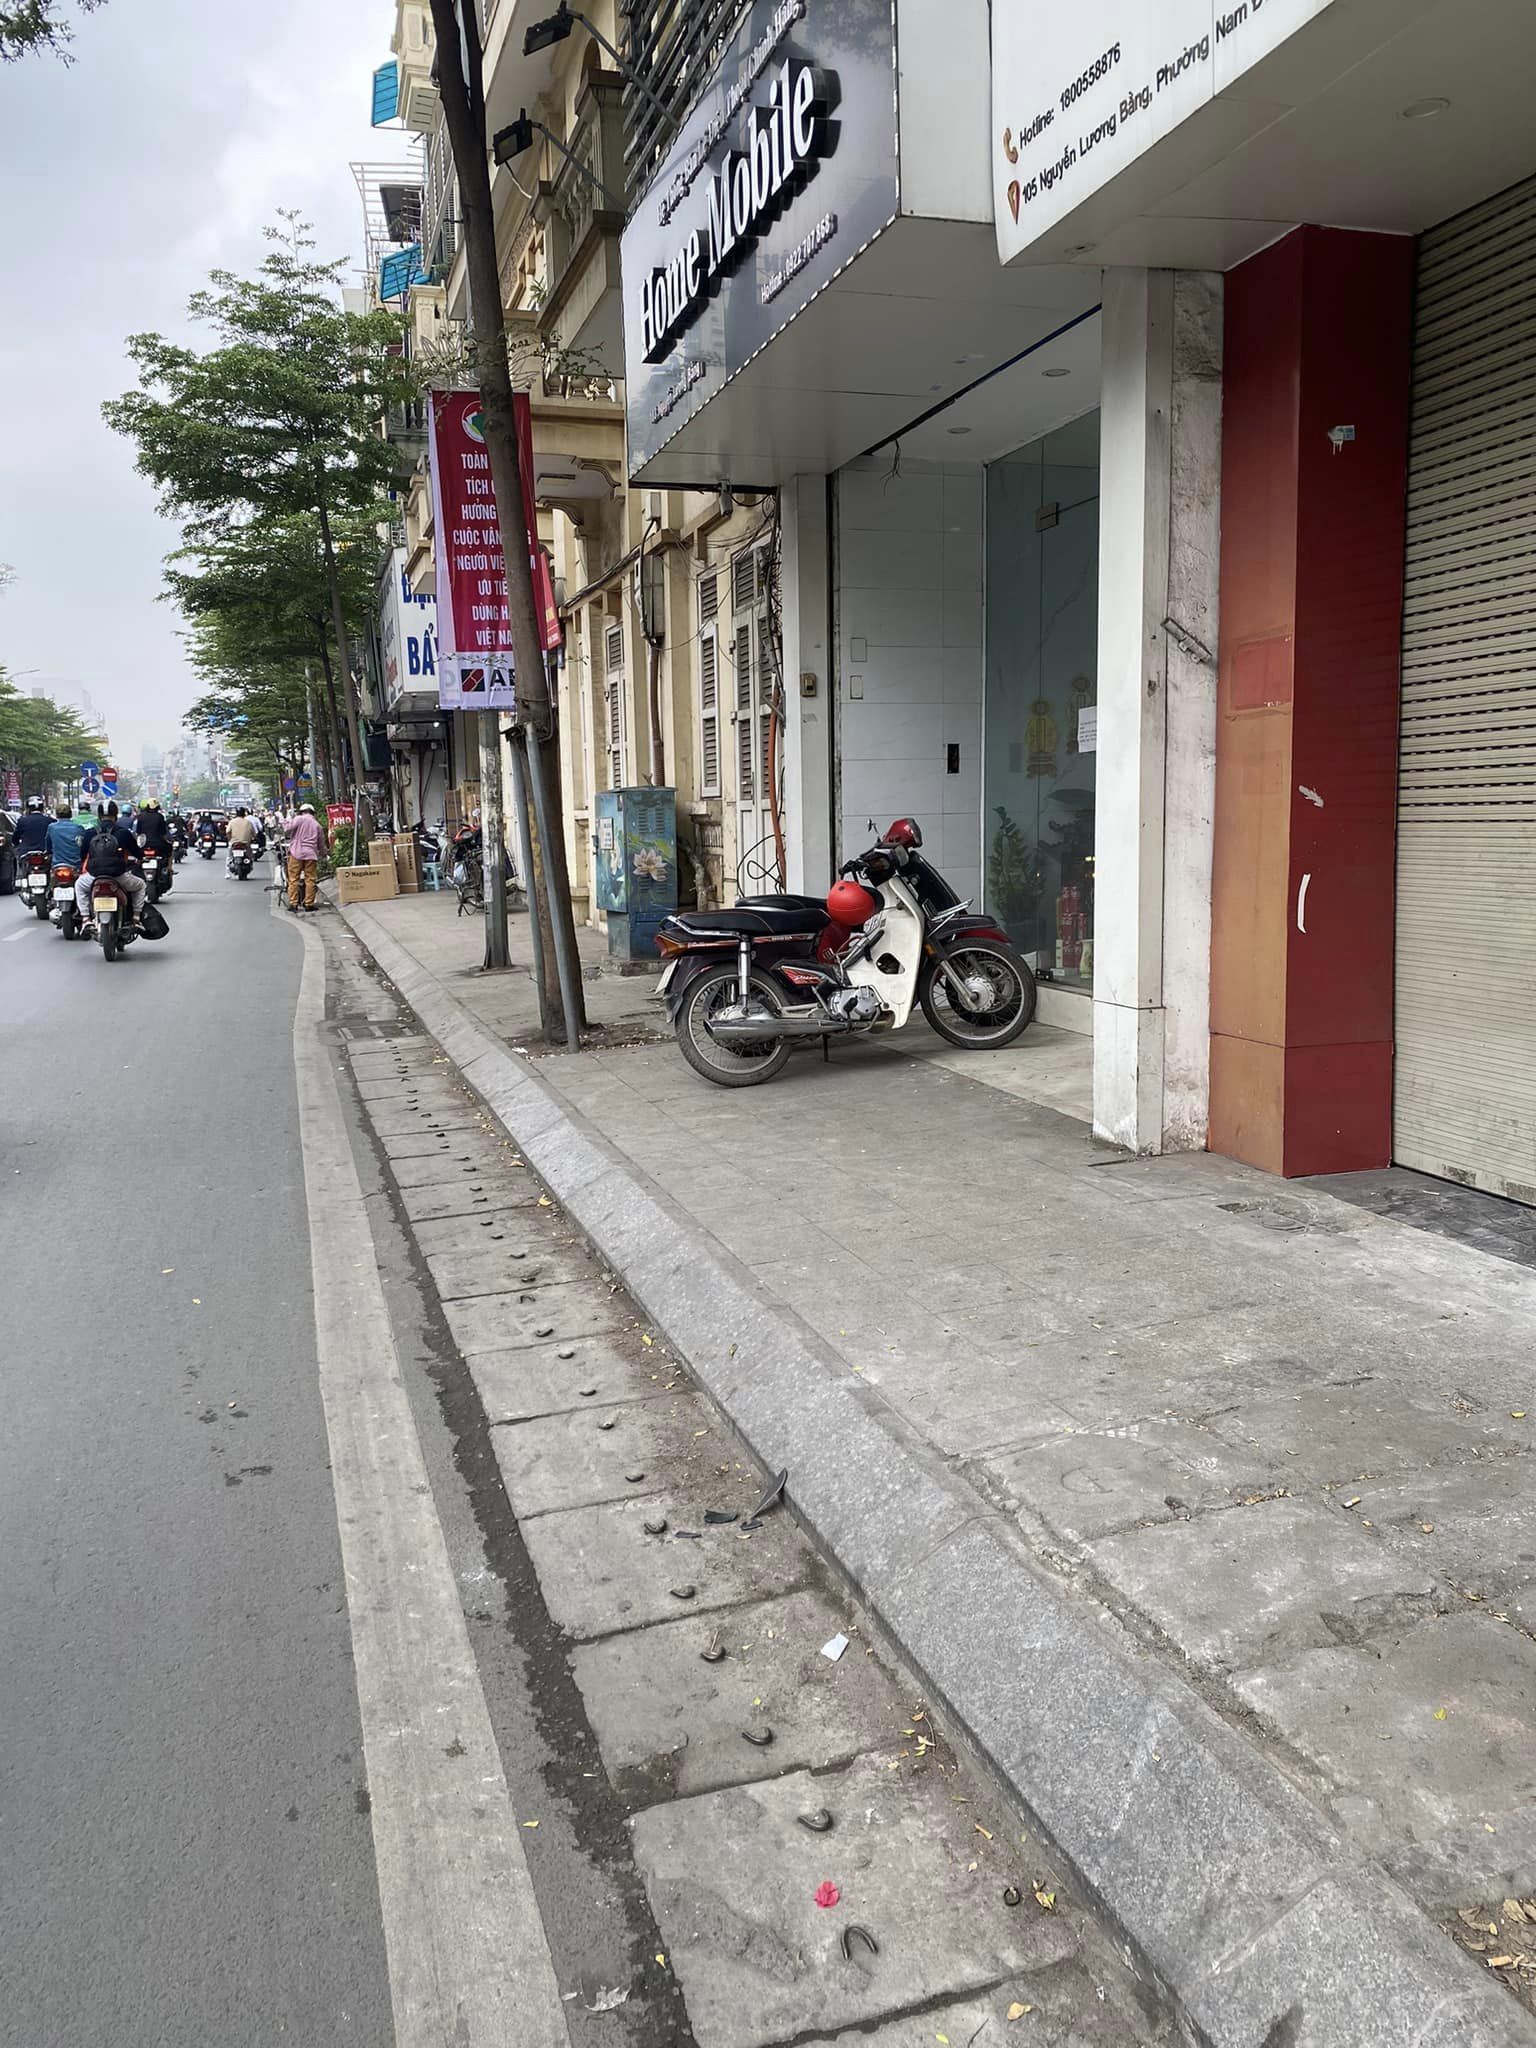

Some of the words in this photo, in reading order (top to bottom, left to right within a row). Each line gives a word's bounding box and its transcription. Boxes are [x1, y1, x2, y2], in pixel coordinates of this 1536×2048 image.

[1020, 108, 1054, 149] Hotline:
[1059, 42, 1121, 112] 1800558876
[1022, 177, 1037, 204] 105
[1039, 144, 1077, 191] Nguyễn
[1079, 113, 1117, 157] Lương
[1156, 35, 1209, 92] Phường
[1215, 3, 1248, 43] Nam
[641, 229, 700, 363] Home
[705, 57, 815, 277] Mobile
[461, 450, 488, 469] TOÀN
[465, 476, 488, 495] TÍCH
[461, 498, 497, 519] HƯỞNG
[452, 526, 480, 548] CUỘC
[456, 551, 488, 571] NGƯỜI
[490, 552, 505, 574] VIỆ
[478, 579, 492, 596] ƯU
[494, 577, 509, 596] TIÊ
[471, 602, 499, 620] DÙNG
[475, 626, 496, 648] VIỆT
[498, 630, 512, 645] NA
[407, 622, 439, 676] BẨ
